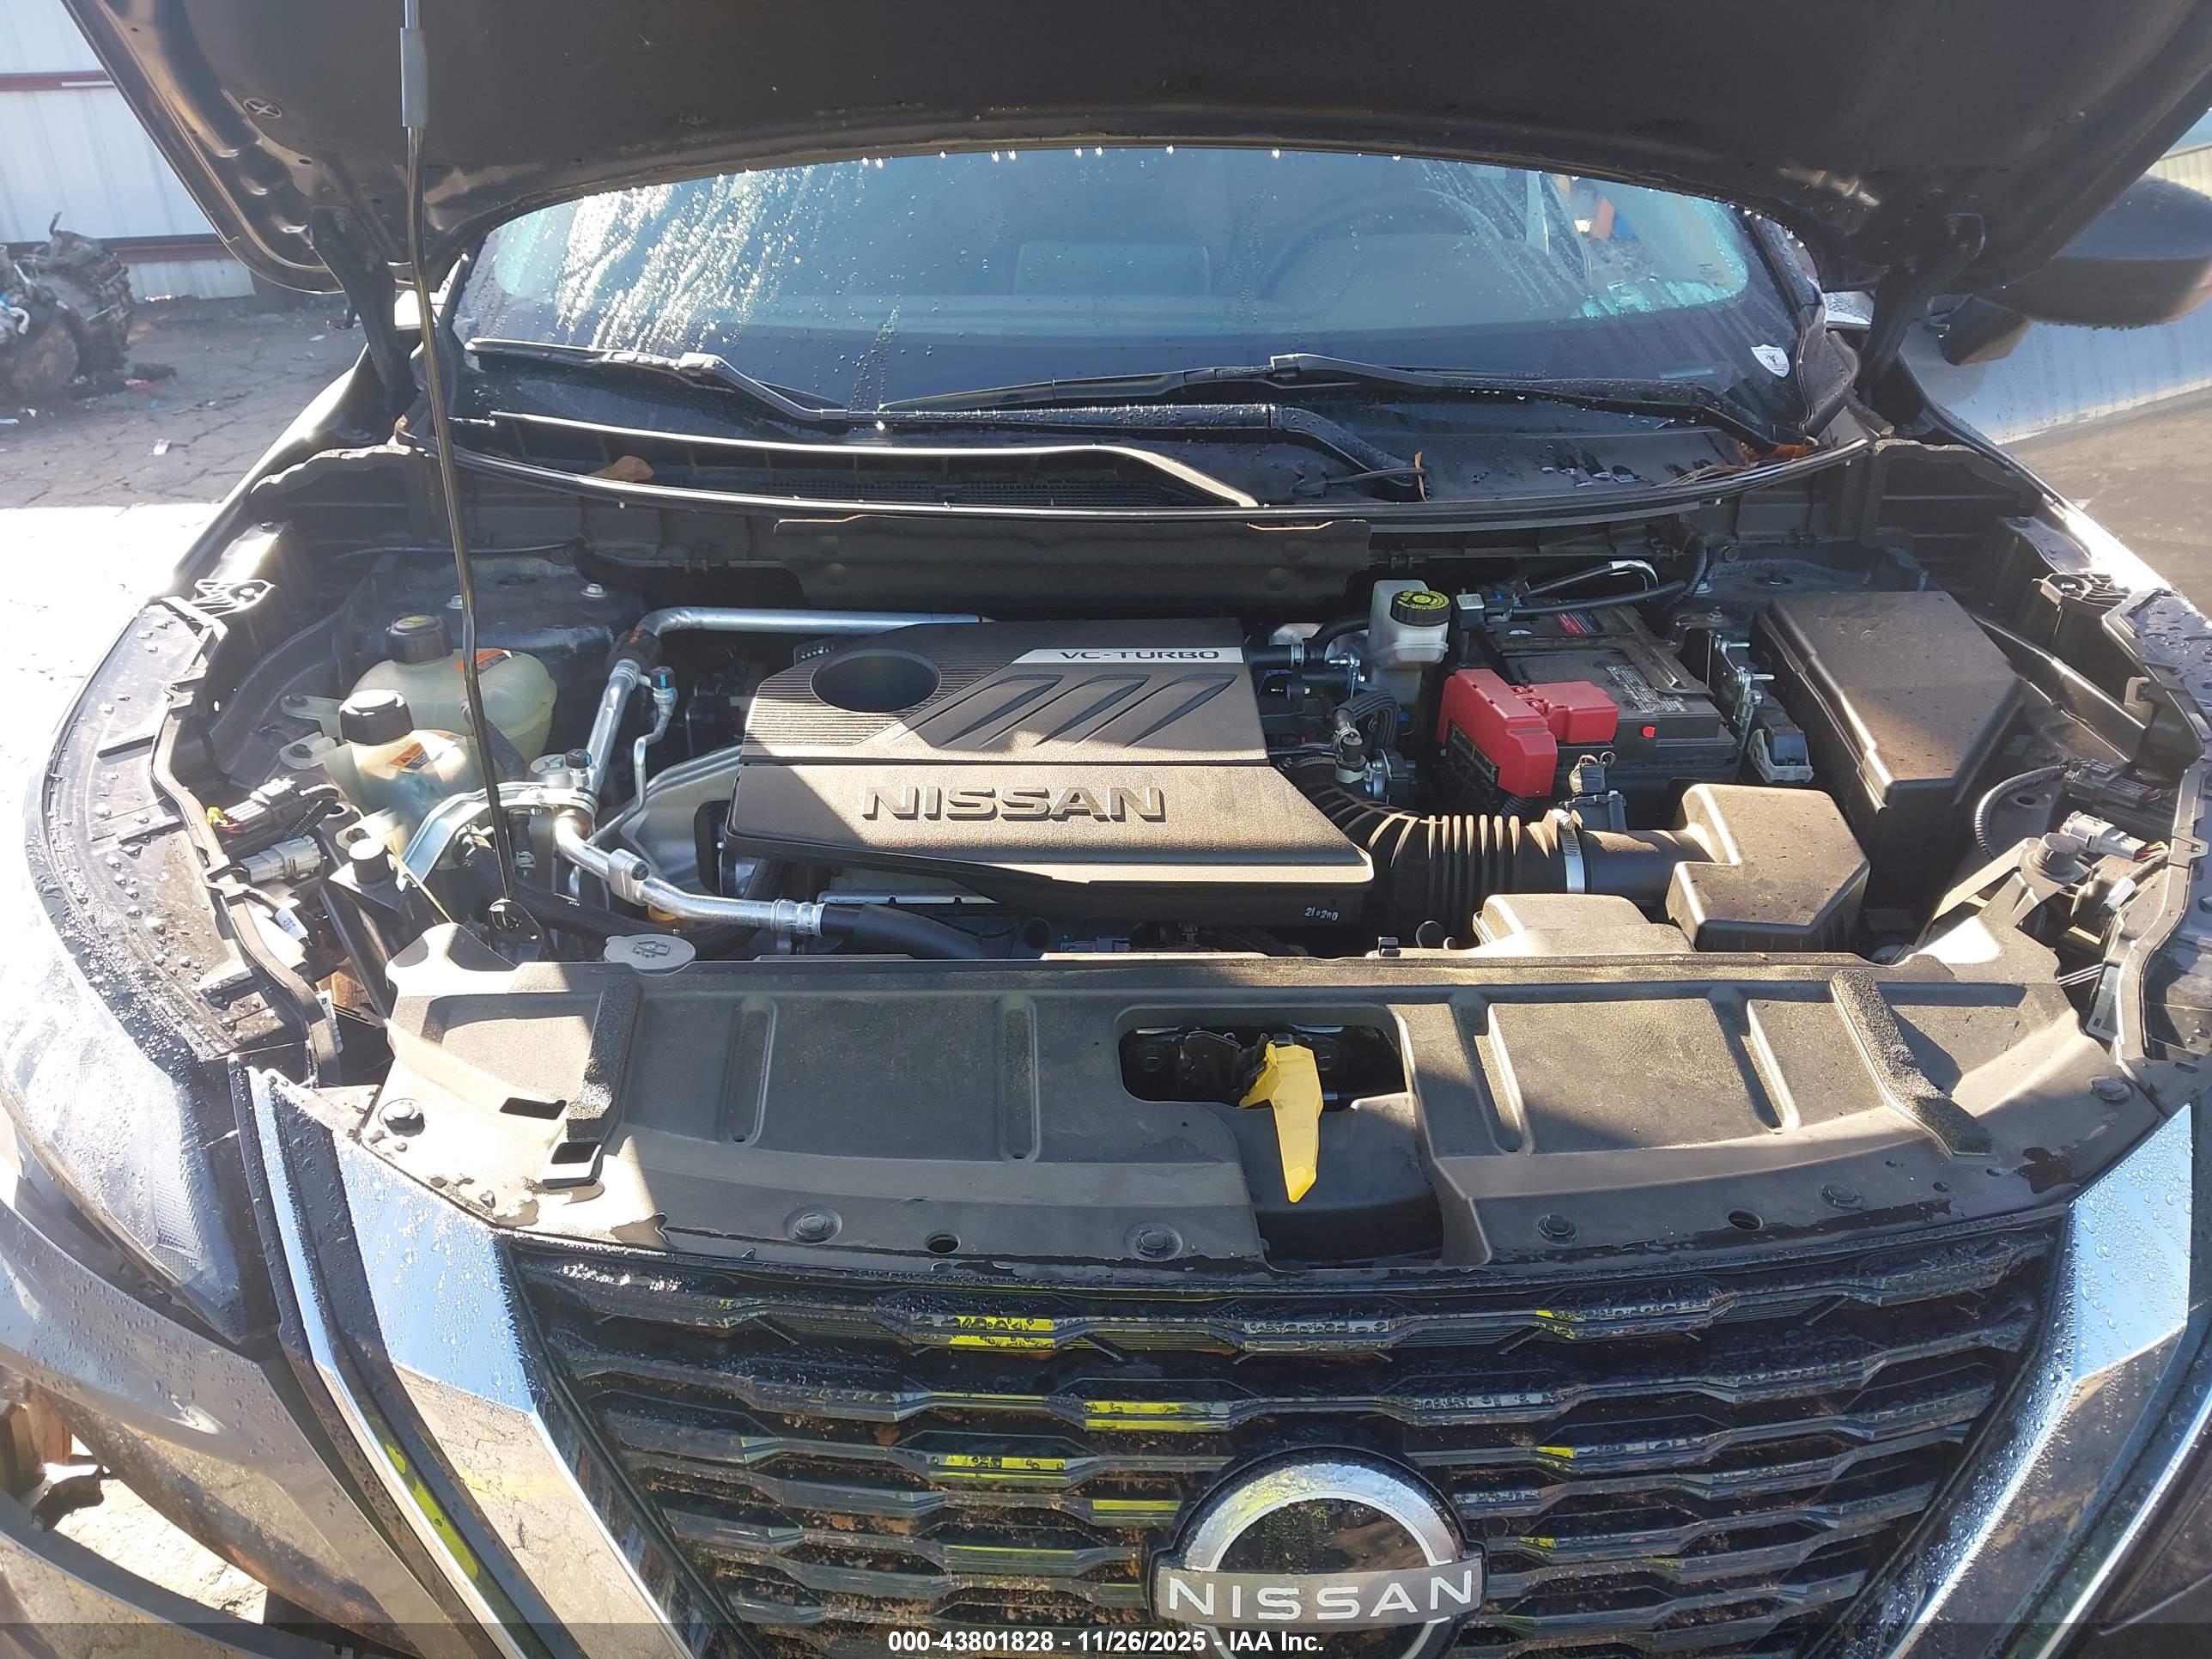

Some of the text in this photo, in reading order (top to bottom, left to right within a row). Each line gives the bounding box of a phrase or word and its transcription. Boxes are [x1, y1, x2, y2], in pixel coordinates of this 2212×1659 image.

[1060, 650, 1220, 659] VC-TURBO
[861, 786, 1166, 823] NISSAN
[1169, 1569, 1473, 1621] NISSAN
